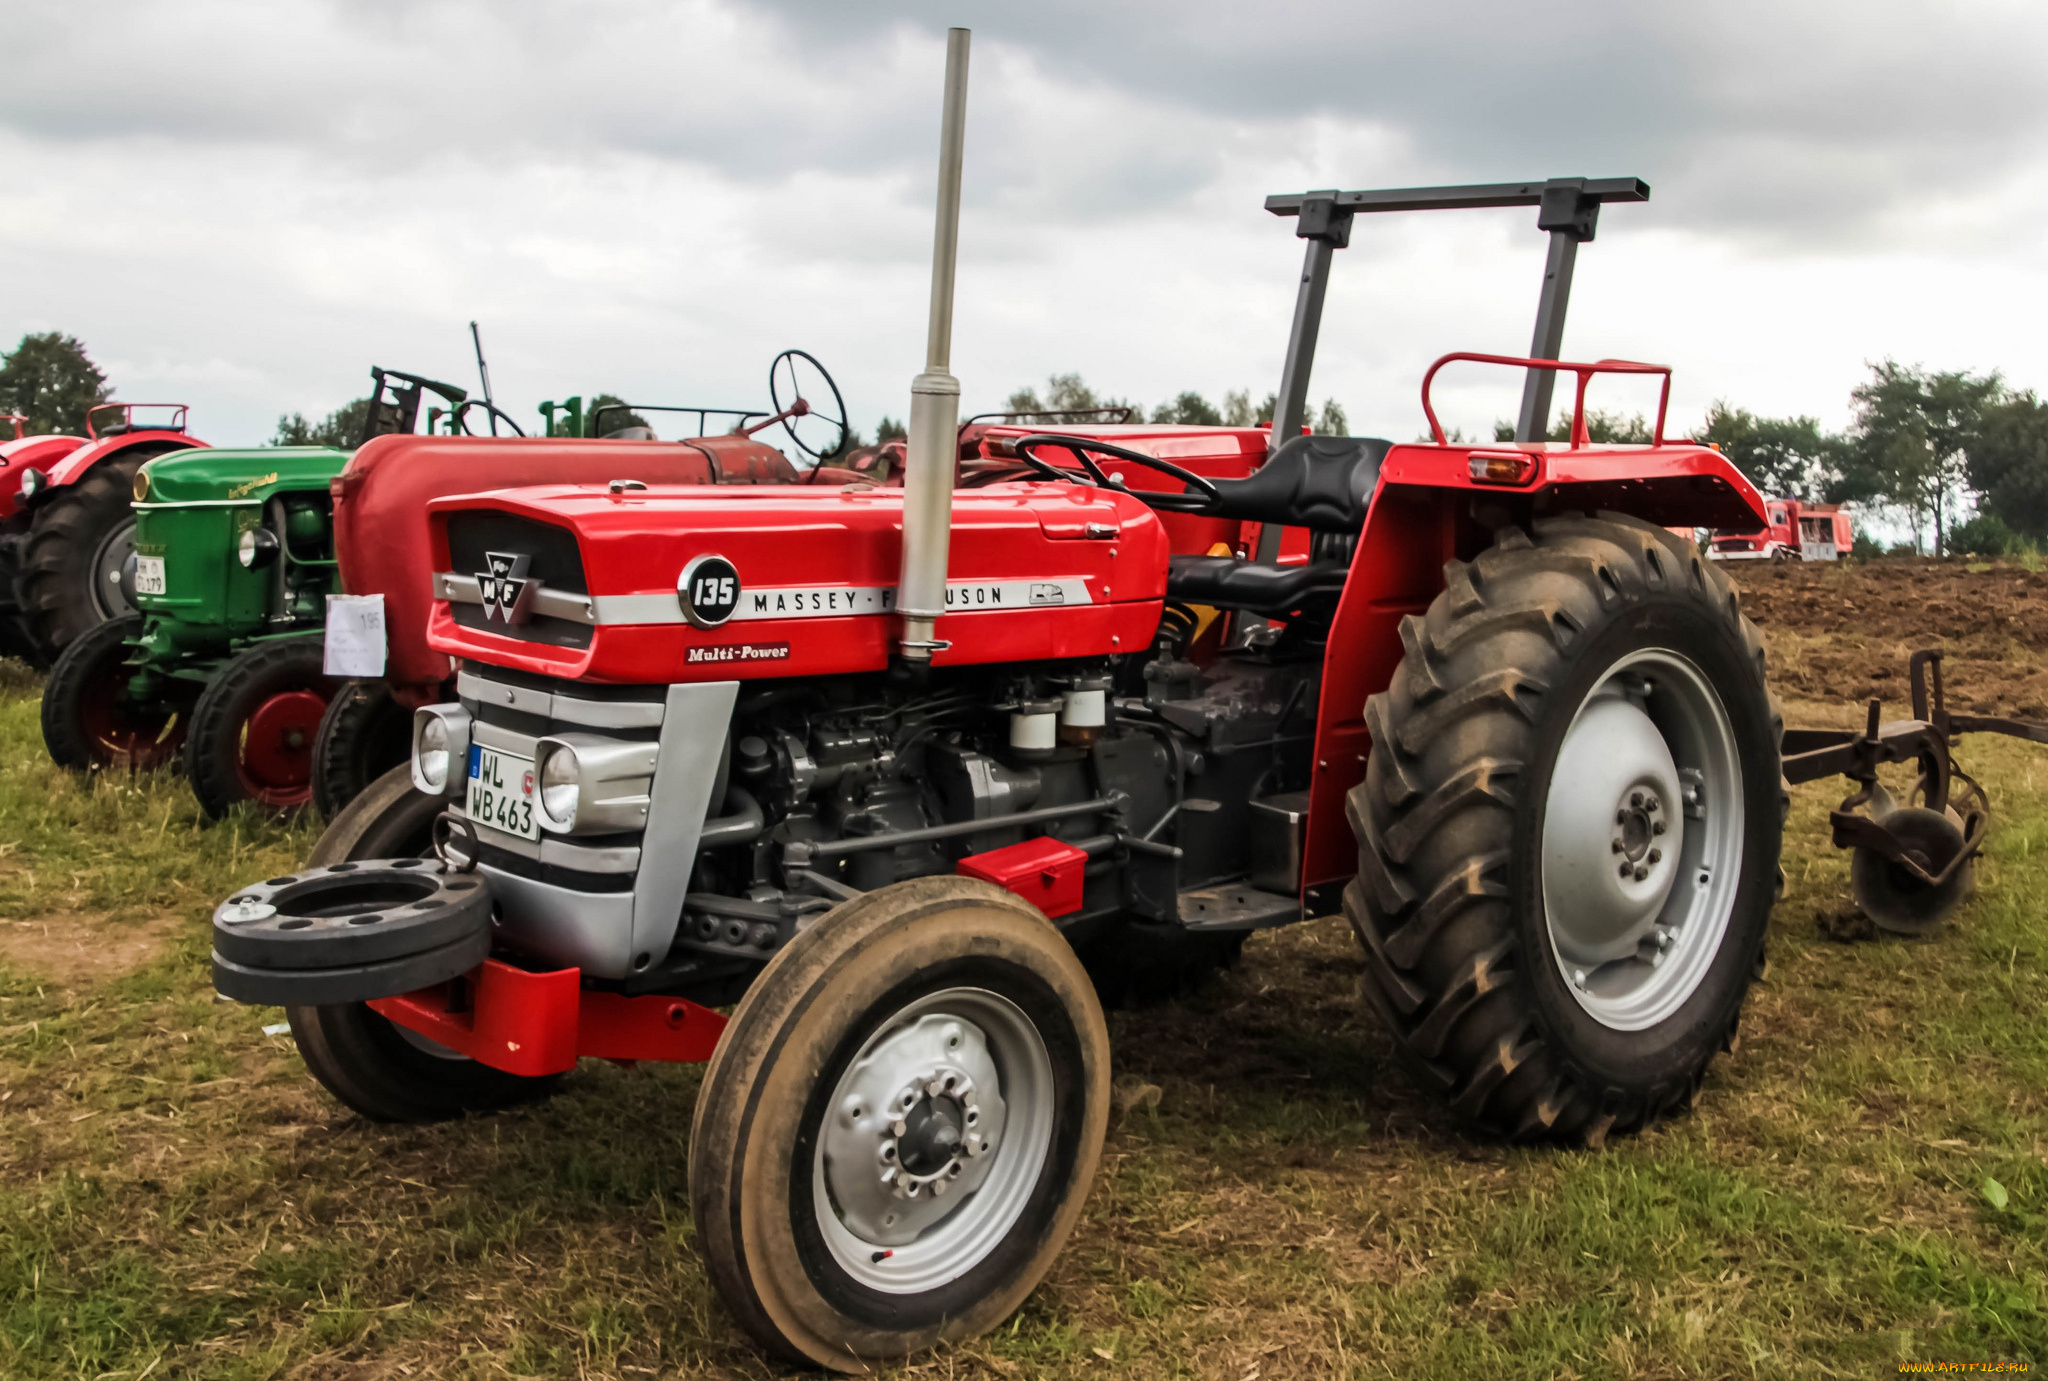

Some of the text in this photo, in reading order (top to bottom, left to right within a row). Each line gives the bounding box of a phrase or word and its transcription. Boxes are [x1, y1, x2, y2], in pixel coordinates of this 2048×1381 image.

[694, 577, 734, 606] 135
[688, 646, 788, 662] Multi-Power
[483, 753, 503, 788] WL
